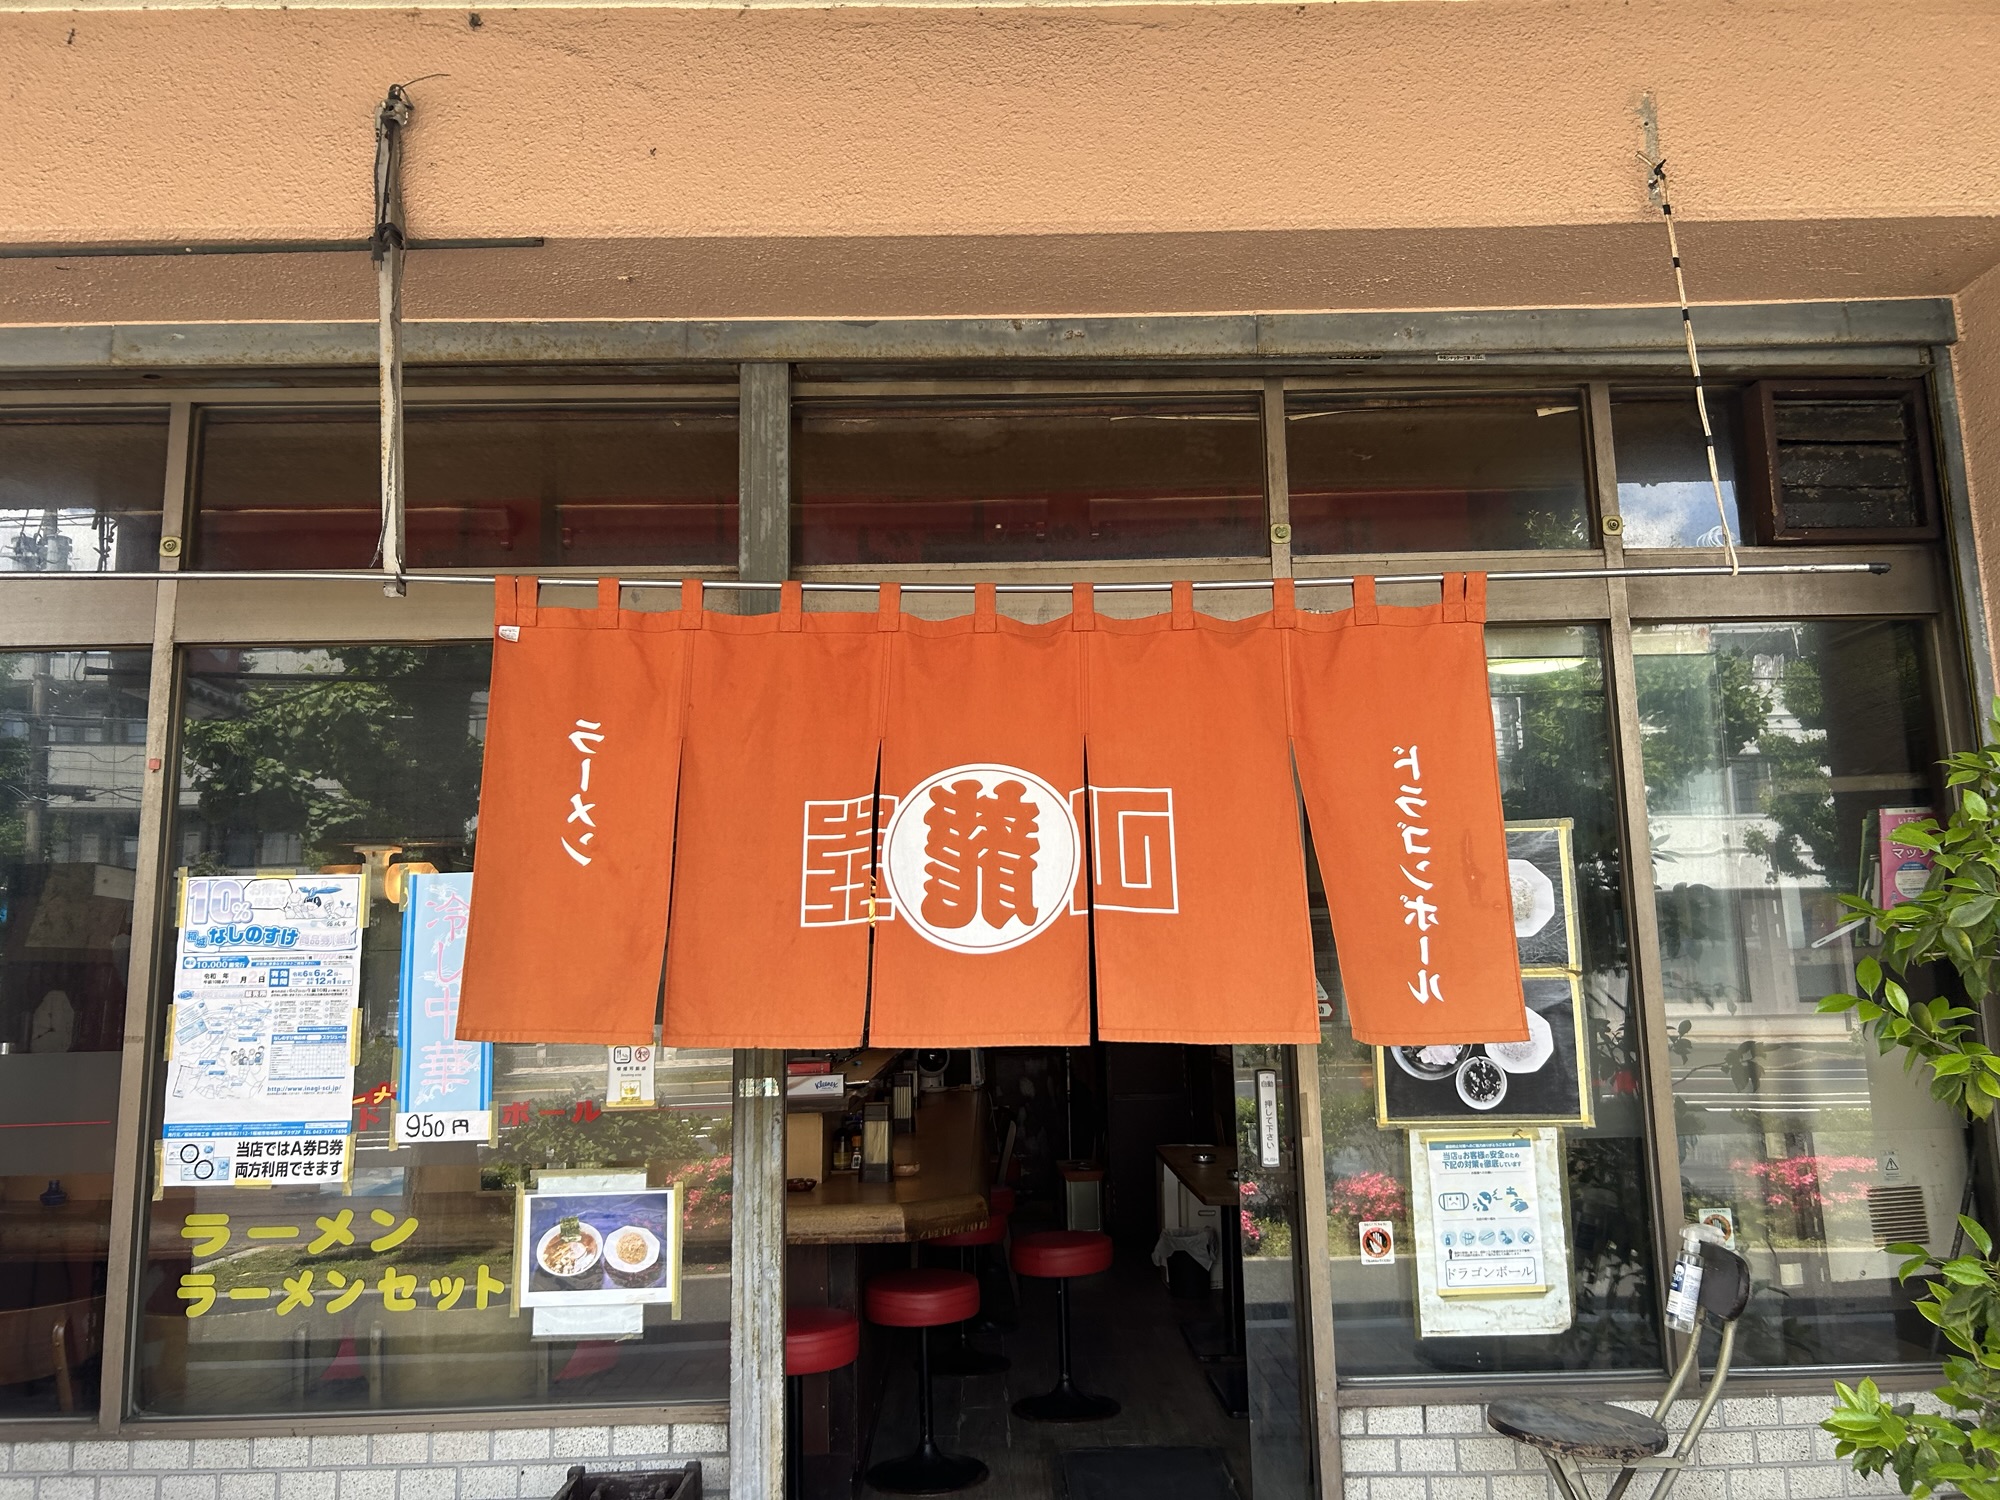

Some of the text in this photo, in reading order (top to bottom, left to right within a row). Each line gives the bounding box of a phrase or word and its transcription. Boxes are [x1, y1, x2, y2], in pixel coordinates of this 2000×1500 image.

[190, 880, 253, 925] 10%
[419, 891, 472, 1095] 冷し中華
[814, 1080, 839, 1090] Kleenex
[1264, 1099, 1275, 1150] 押して下さい
[236, 1139, 343, 1158] 当店ではA券B券
[1442, 1150, 1520, 1161] 当店はお客様の安全のため
[235, 1159, 343, 1179] 両方利用できます
[1441, 1159, 1522, 1170] 下記の対策を徹底しています
[180, 1208, 419, 1257] ラーメン
[1447, 1265, 1534, 1281] ドラゴンボール
[176, 1263, 505, 1319] ラーメンセット
